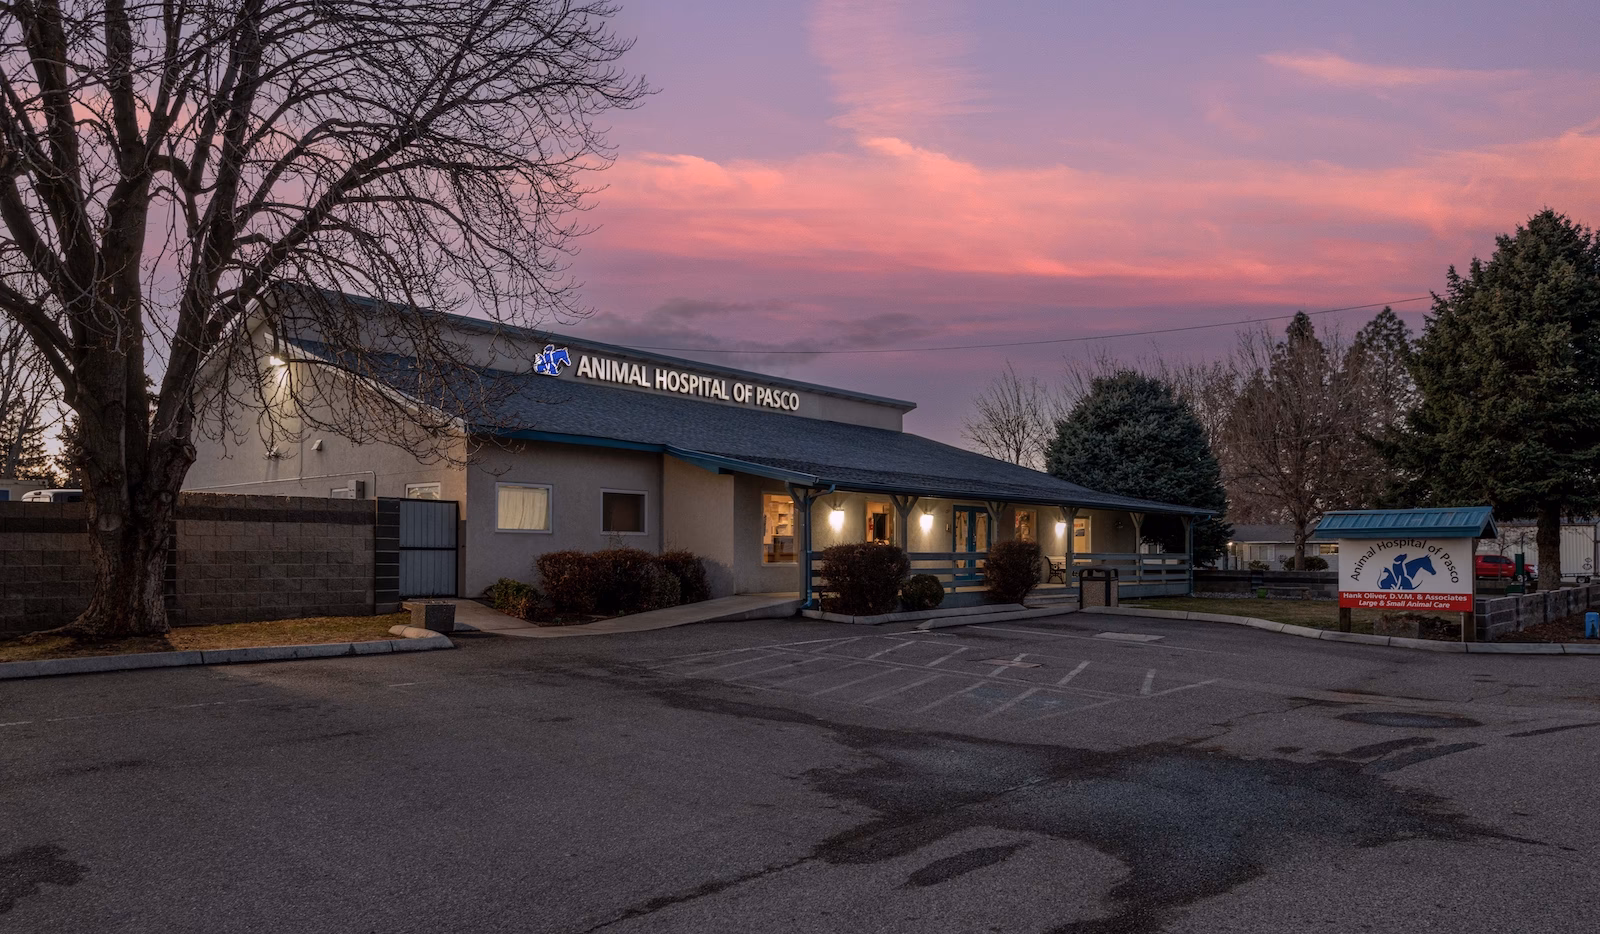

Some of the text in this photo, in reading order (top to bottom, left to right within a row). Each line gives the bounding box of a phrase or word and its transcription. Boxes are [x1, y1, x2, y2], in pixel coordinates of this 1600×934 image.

[577, 355, 800, 411] ANIMAL HOSPITAL OF PASCO
[1351, 538, 1459, 583] Animal Hospital of Pasco
[1359, 600, 1378, 608] Large
[1425, 594, 1467, 602] Associates
